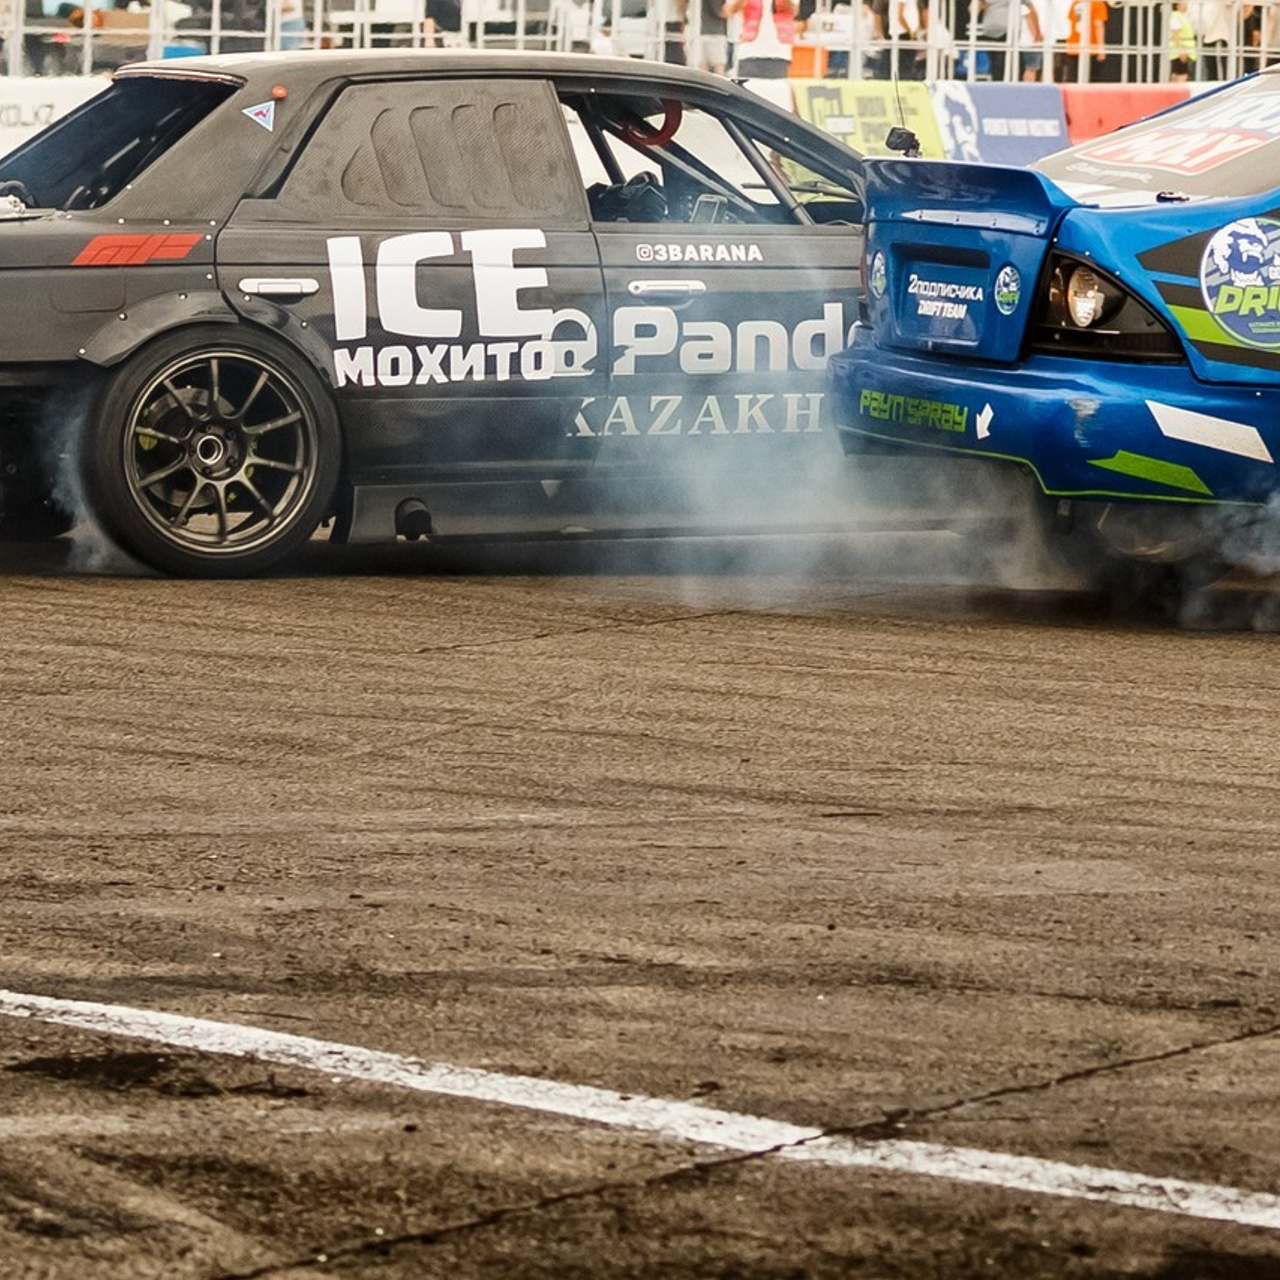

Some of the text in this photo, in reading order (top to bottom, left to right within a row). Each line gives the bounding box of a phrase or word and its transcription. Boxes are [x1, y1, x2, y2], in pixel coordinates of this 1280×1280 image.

[327, 229, 553, 341] ICE
[333, 340, 556, 389] МОХИТО
[612, 302, 872, 376] Pand
